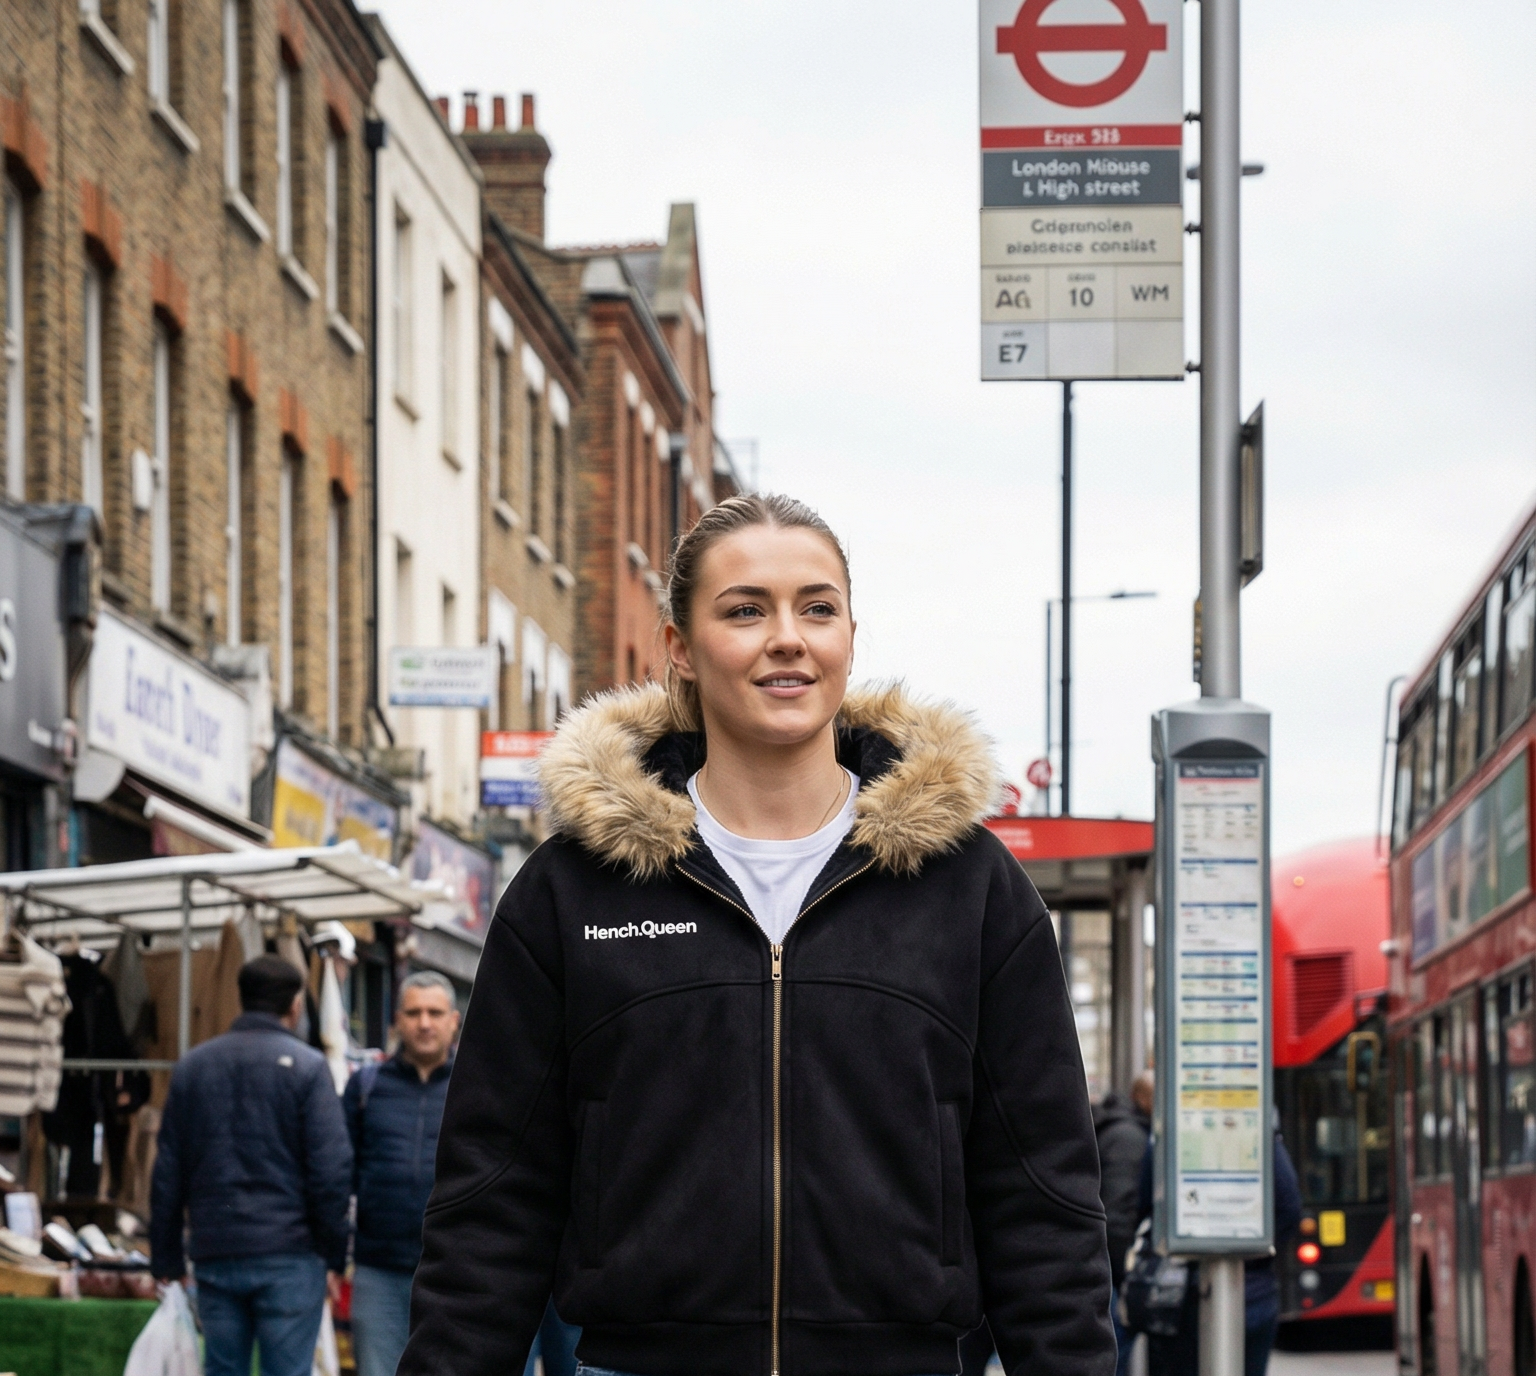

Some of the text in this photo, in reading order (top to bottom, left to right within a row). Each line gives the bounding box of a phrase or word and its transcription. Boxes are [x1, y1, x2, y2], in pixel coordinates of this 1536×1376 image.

[1012, 158, 1081, 177] London
[1037, 179, 1080, 201] High
[1084, 180, 1141, 197] street
[1068, 287, 1095, 308] 10
[1131, 284, 1170, 302] WM
[998, 343, 1028, 363] E7
[584, 920, 697, 939] Hench.Queen
